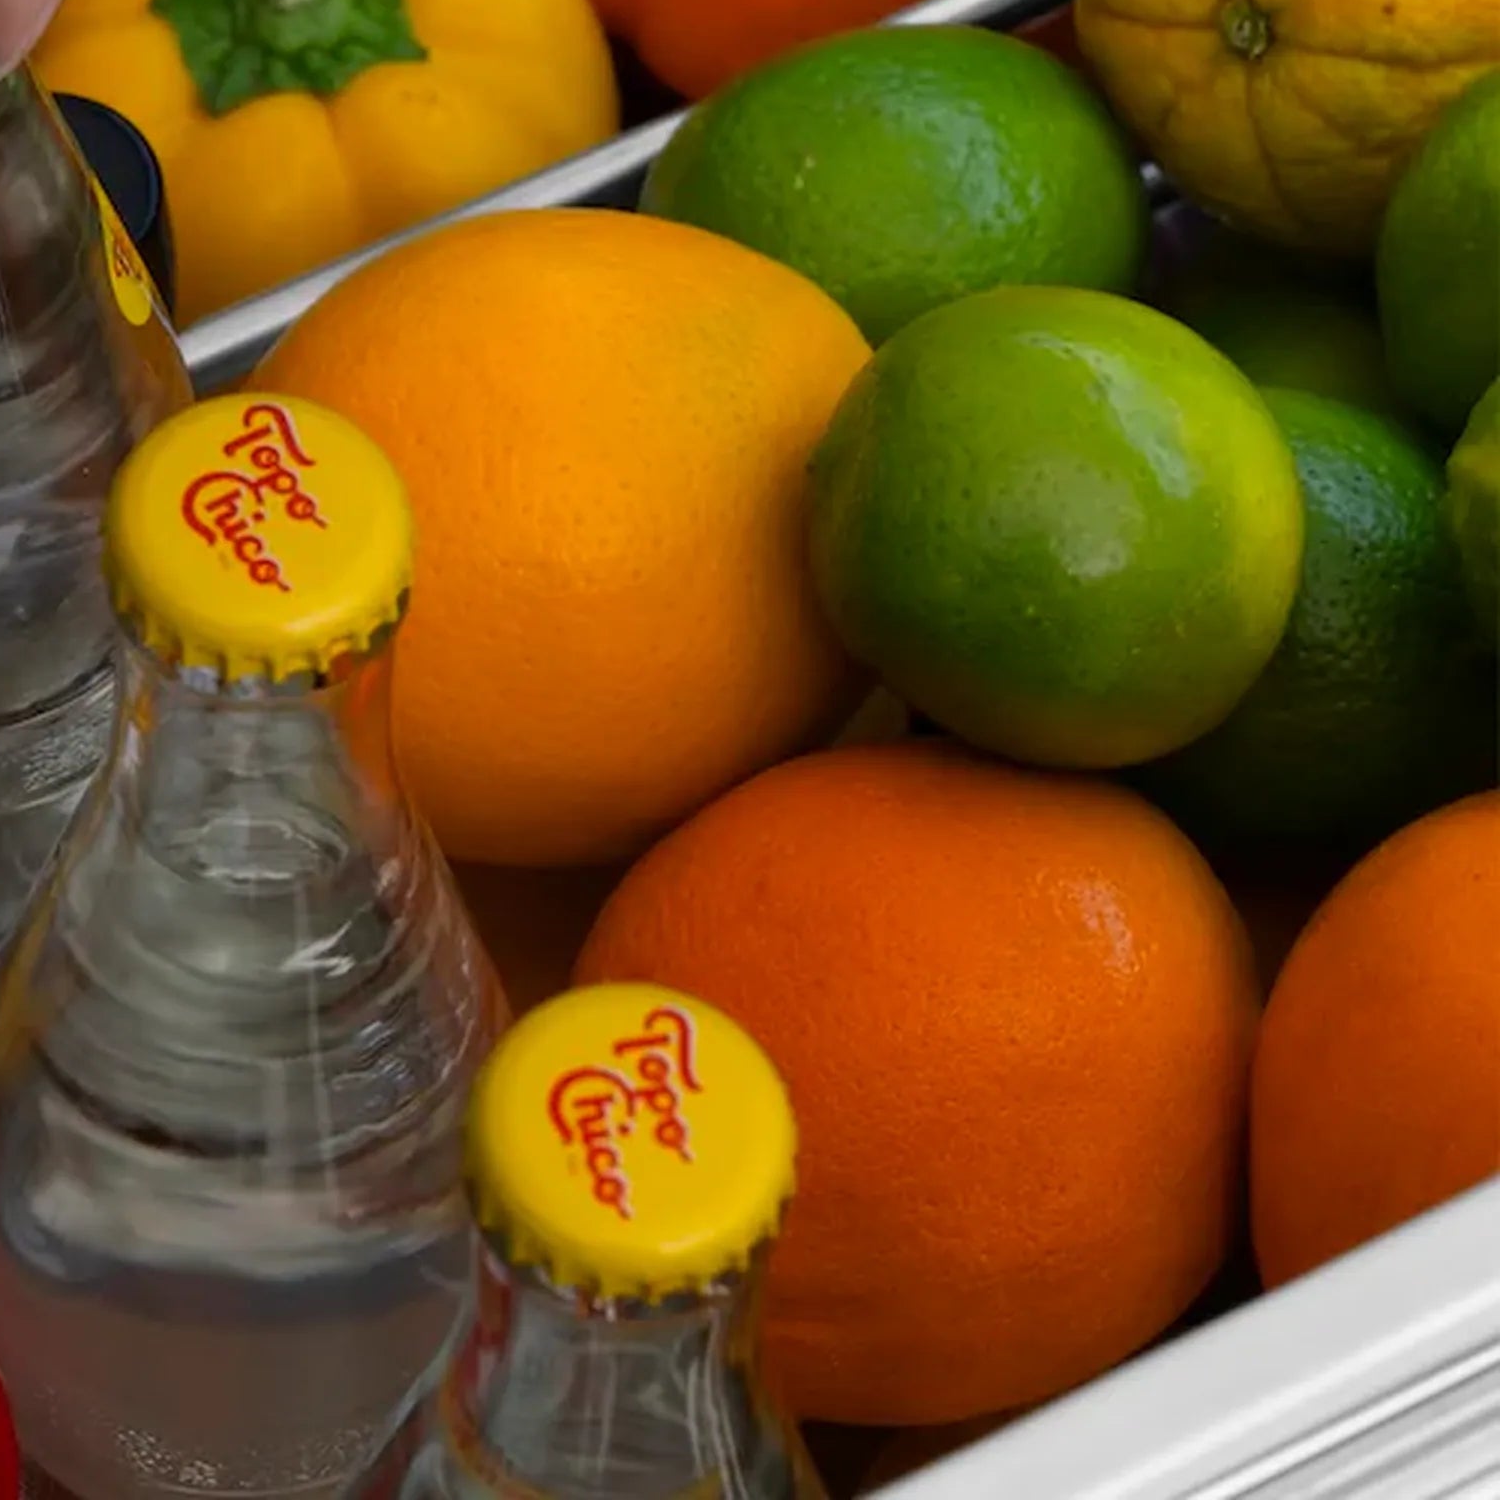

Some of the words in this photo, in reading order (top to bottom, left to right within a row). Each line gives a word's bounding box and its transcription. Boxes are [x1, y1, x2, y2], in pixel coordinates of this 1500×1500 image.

[182, 470, 292, 593] Chico
[223, 403, 329, 531] Topo
[548, 1065, 635, 1221] Chico
[613, 1008, 703, 1165] Topo
